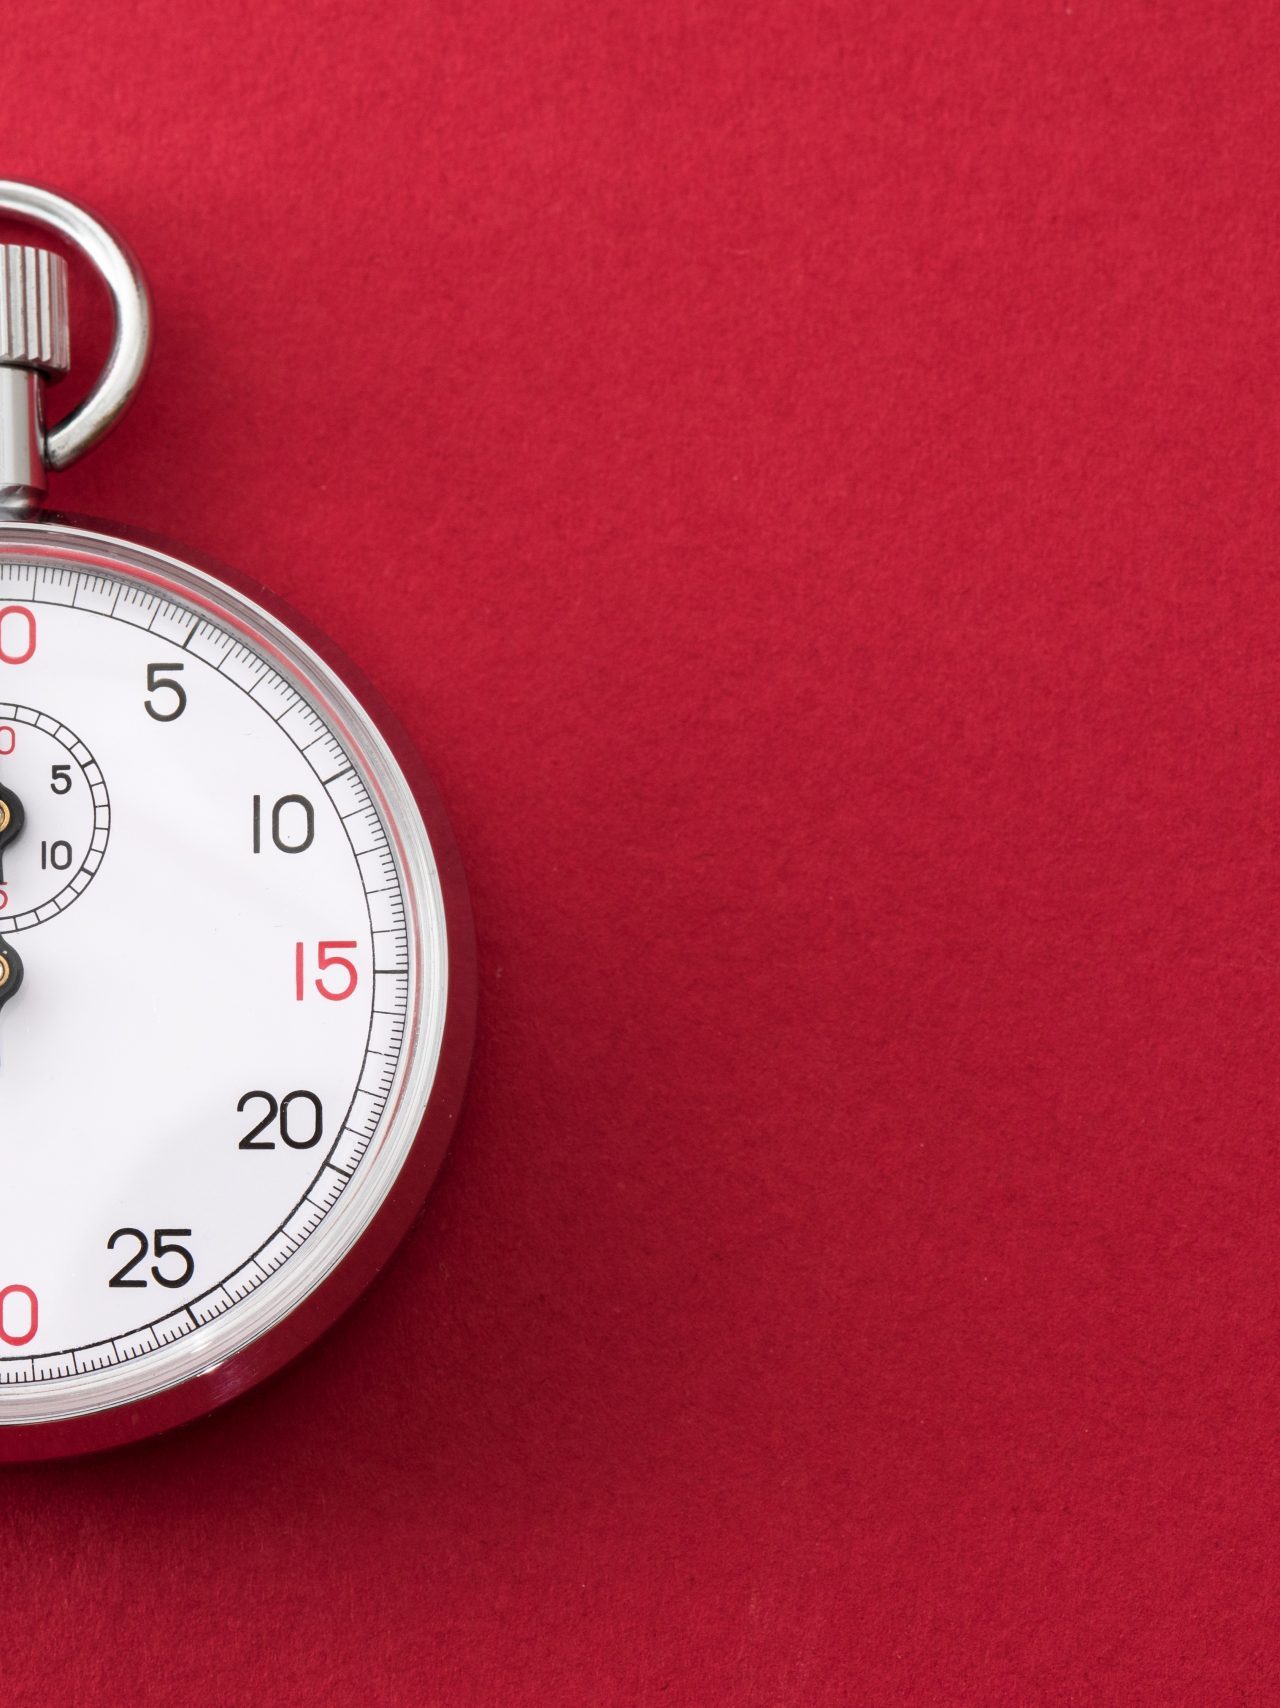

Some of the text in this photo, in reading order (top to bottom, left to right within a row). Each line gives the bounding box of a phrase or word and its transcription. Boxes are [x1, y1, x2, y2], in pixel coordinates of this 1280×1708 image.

[145, 662, 187, 722] 5
[50, 764, 73, 795] 5
[253, 794, 315, 853] 10
[41, 840, 73, 870] 10
[295, 941, 358, 1002] 15
[236, 1090, 324, 1150] 20
[106, 1228, 195, 1288] 25
